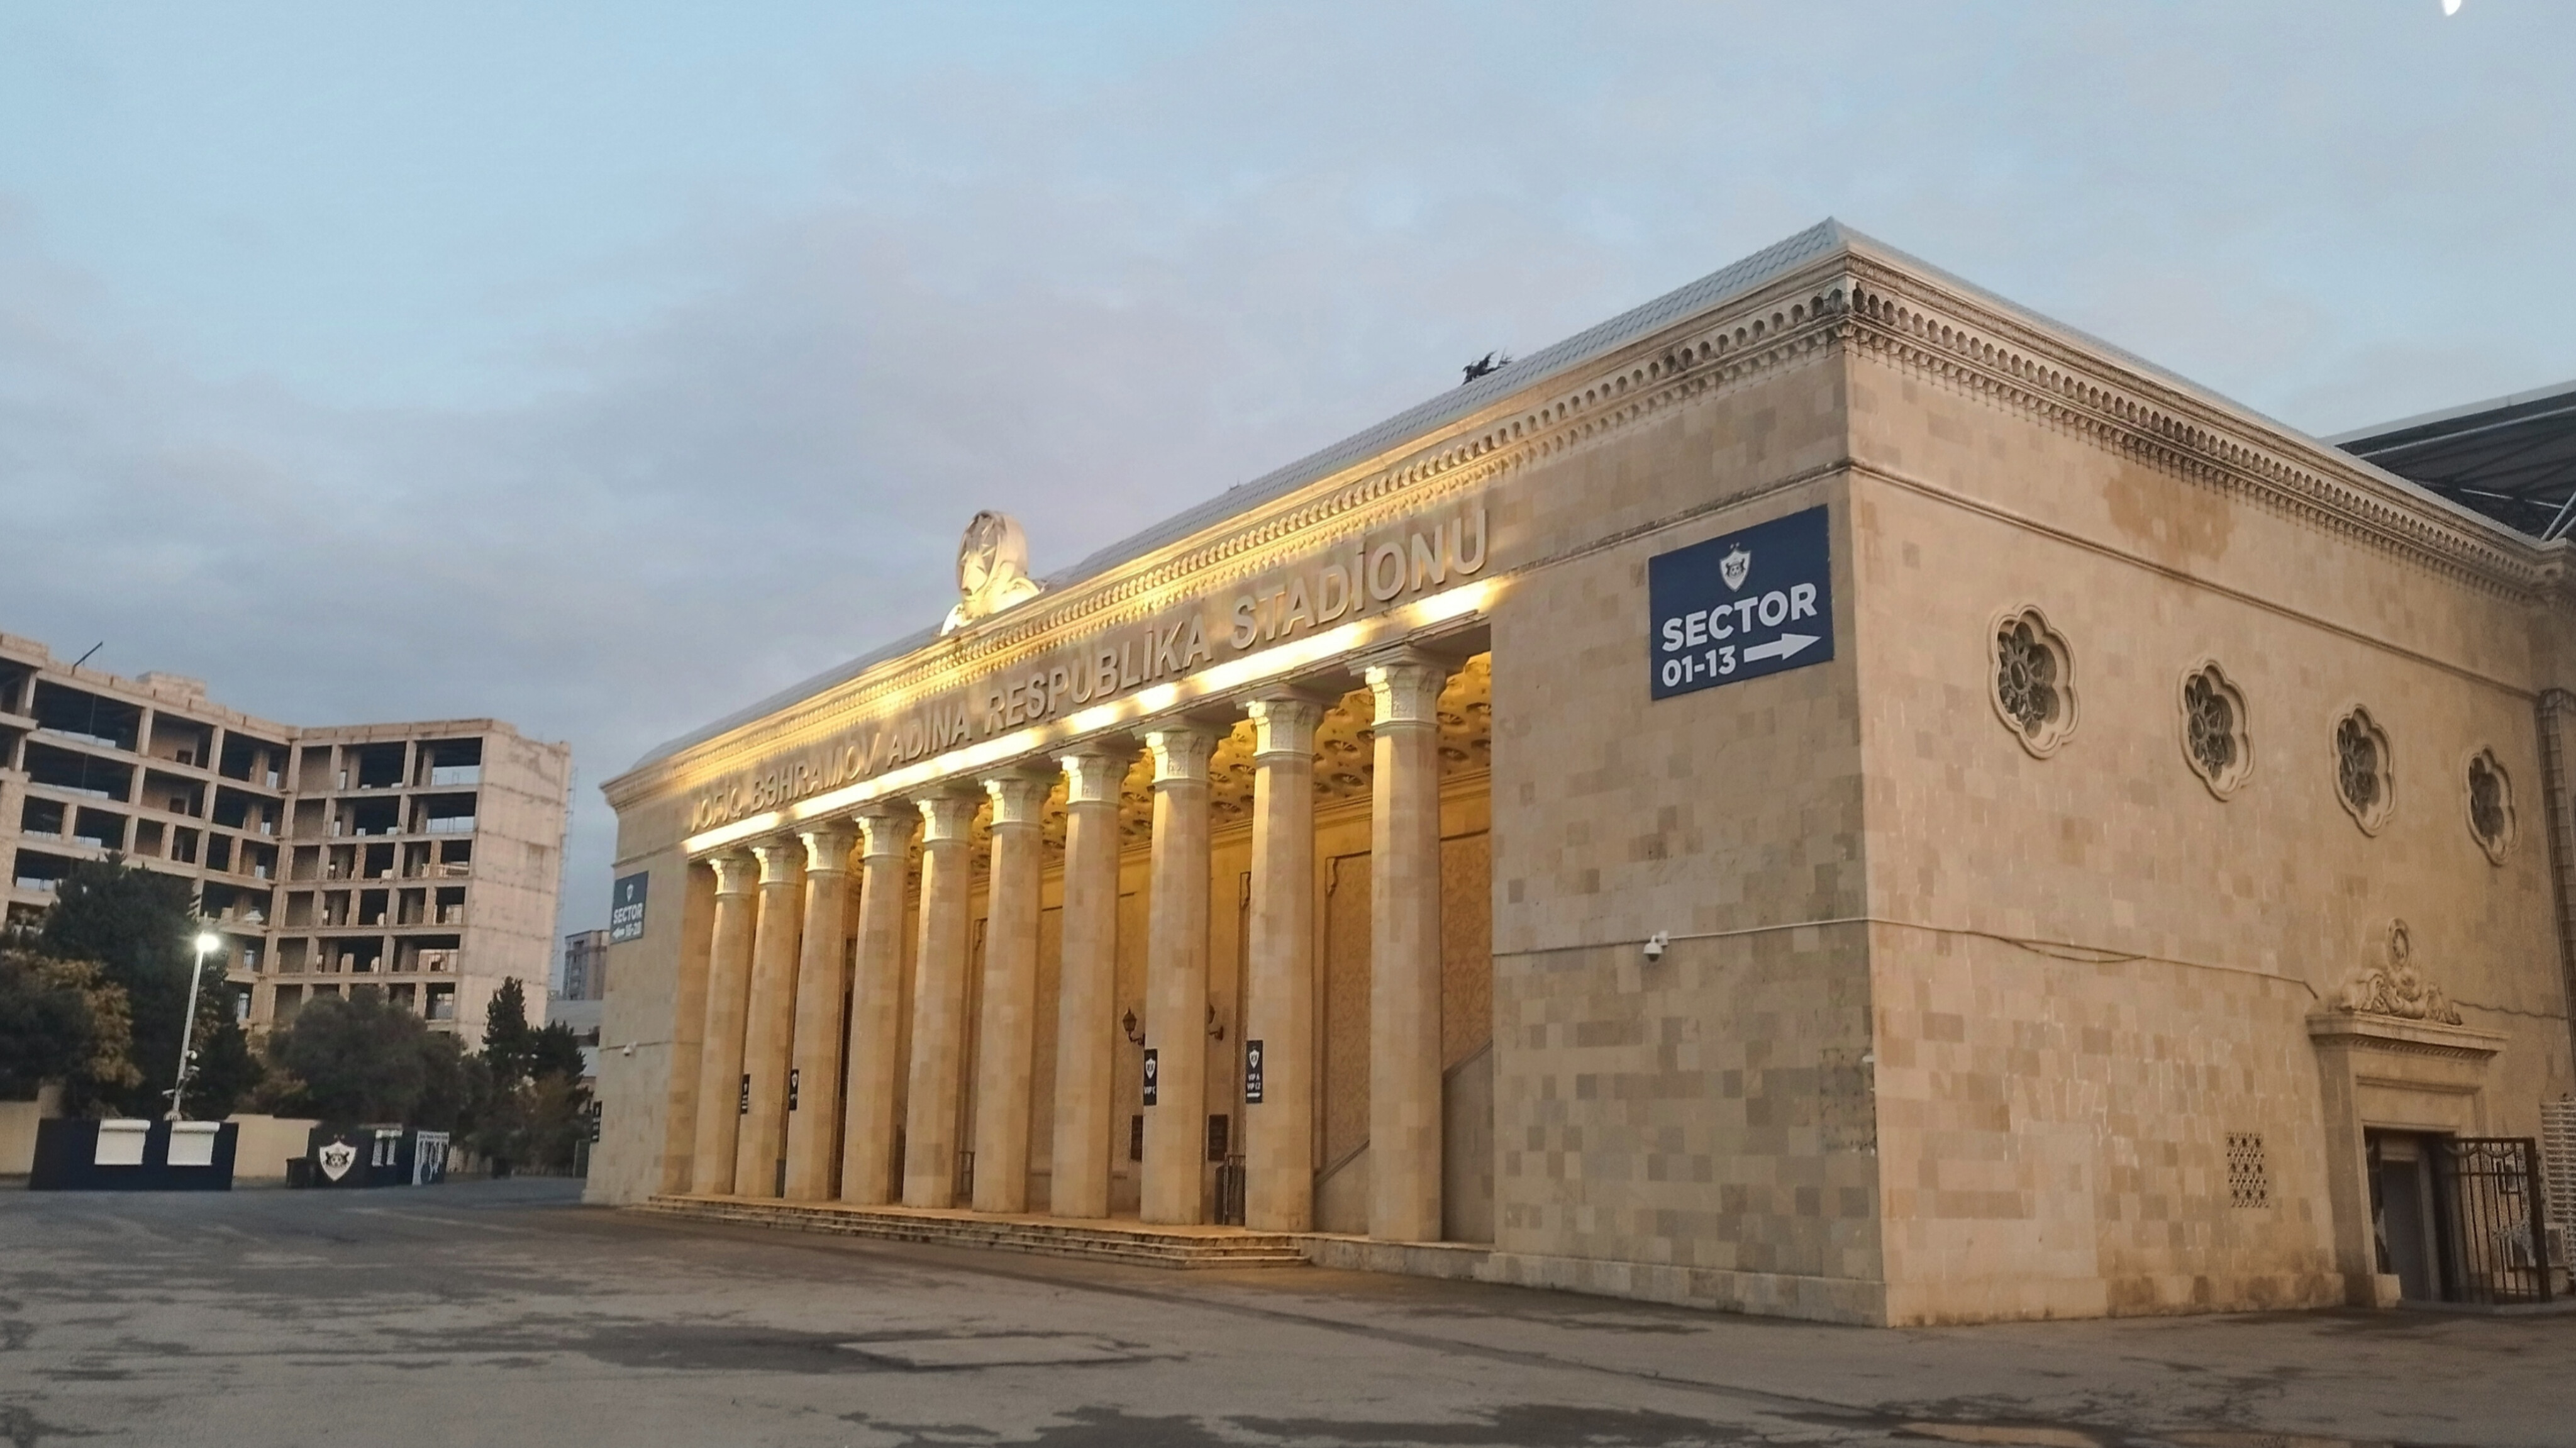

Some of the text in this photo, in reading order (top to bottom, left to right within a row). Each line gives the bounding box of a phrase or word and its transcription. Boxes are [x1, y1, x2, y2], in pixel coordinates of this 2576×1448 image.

[887, 700, 972, 768] ADINA
[984, 613, 1213, 735] RESPUBLİKA
[1230, 508, 1489, 650] STADİONU
[1662, 582, 1817, 652] SECTOR
[1662, 645, 1736, 687] 01-13
[613, 903, 643, 925] SECTOR
